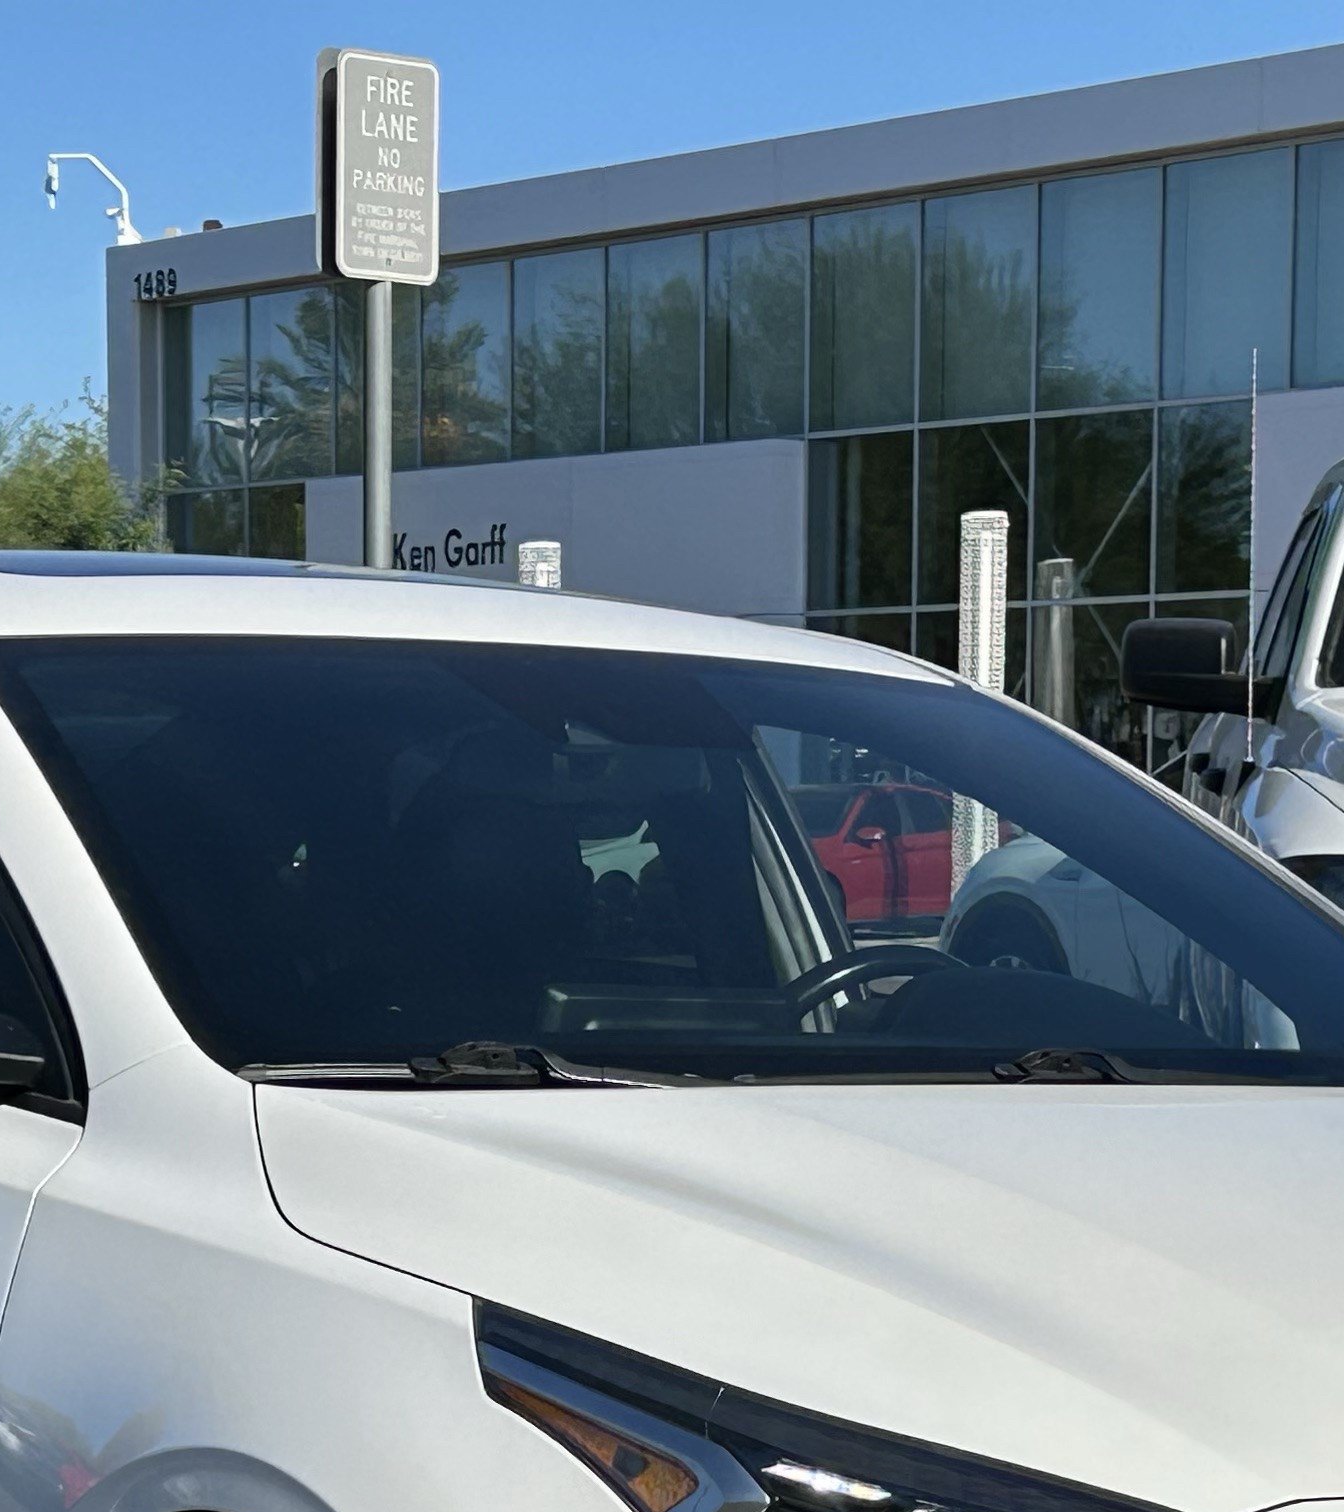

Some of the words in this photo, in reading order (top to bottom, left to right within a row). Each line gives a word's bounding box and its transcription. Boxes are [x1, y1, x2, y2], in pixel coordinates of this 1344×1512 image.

[366, 74, 415, 107] FIRE
[361, 109, 418, 142] LANE
[378, 148, 401, 168] NO
[352, 169, 425, 197] PARKING
[133, 268, 177, 300] 1489
[392, 532, 436, 573] Ken
[444, 523, 507, 568] Garff
